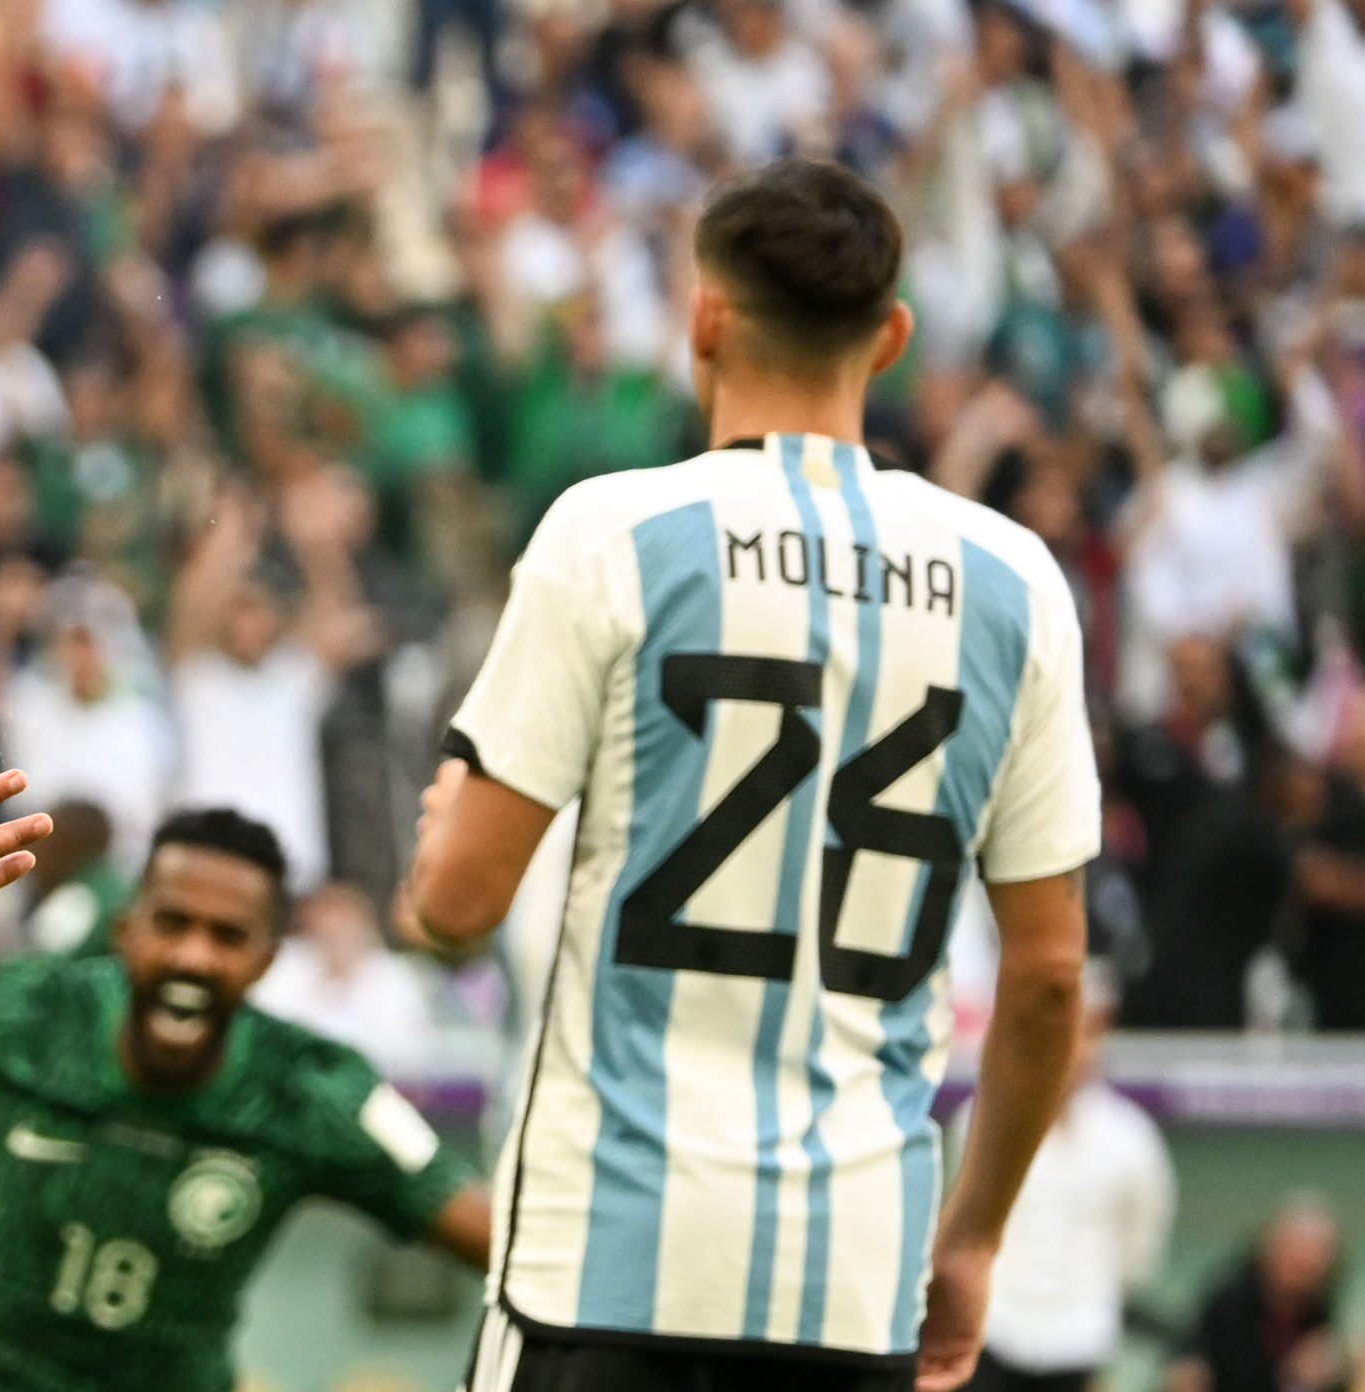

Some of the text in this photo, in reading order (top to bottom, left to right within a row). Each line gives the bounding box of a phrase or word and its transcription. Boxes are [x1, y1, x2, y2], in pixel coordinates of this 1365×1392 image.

[725, 527, 955, 617] MOLINA
[613, 652, 966, 1001] 26
[50, 1220, 159, 1332] 18
